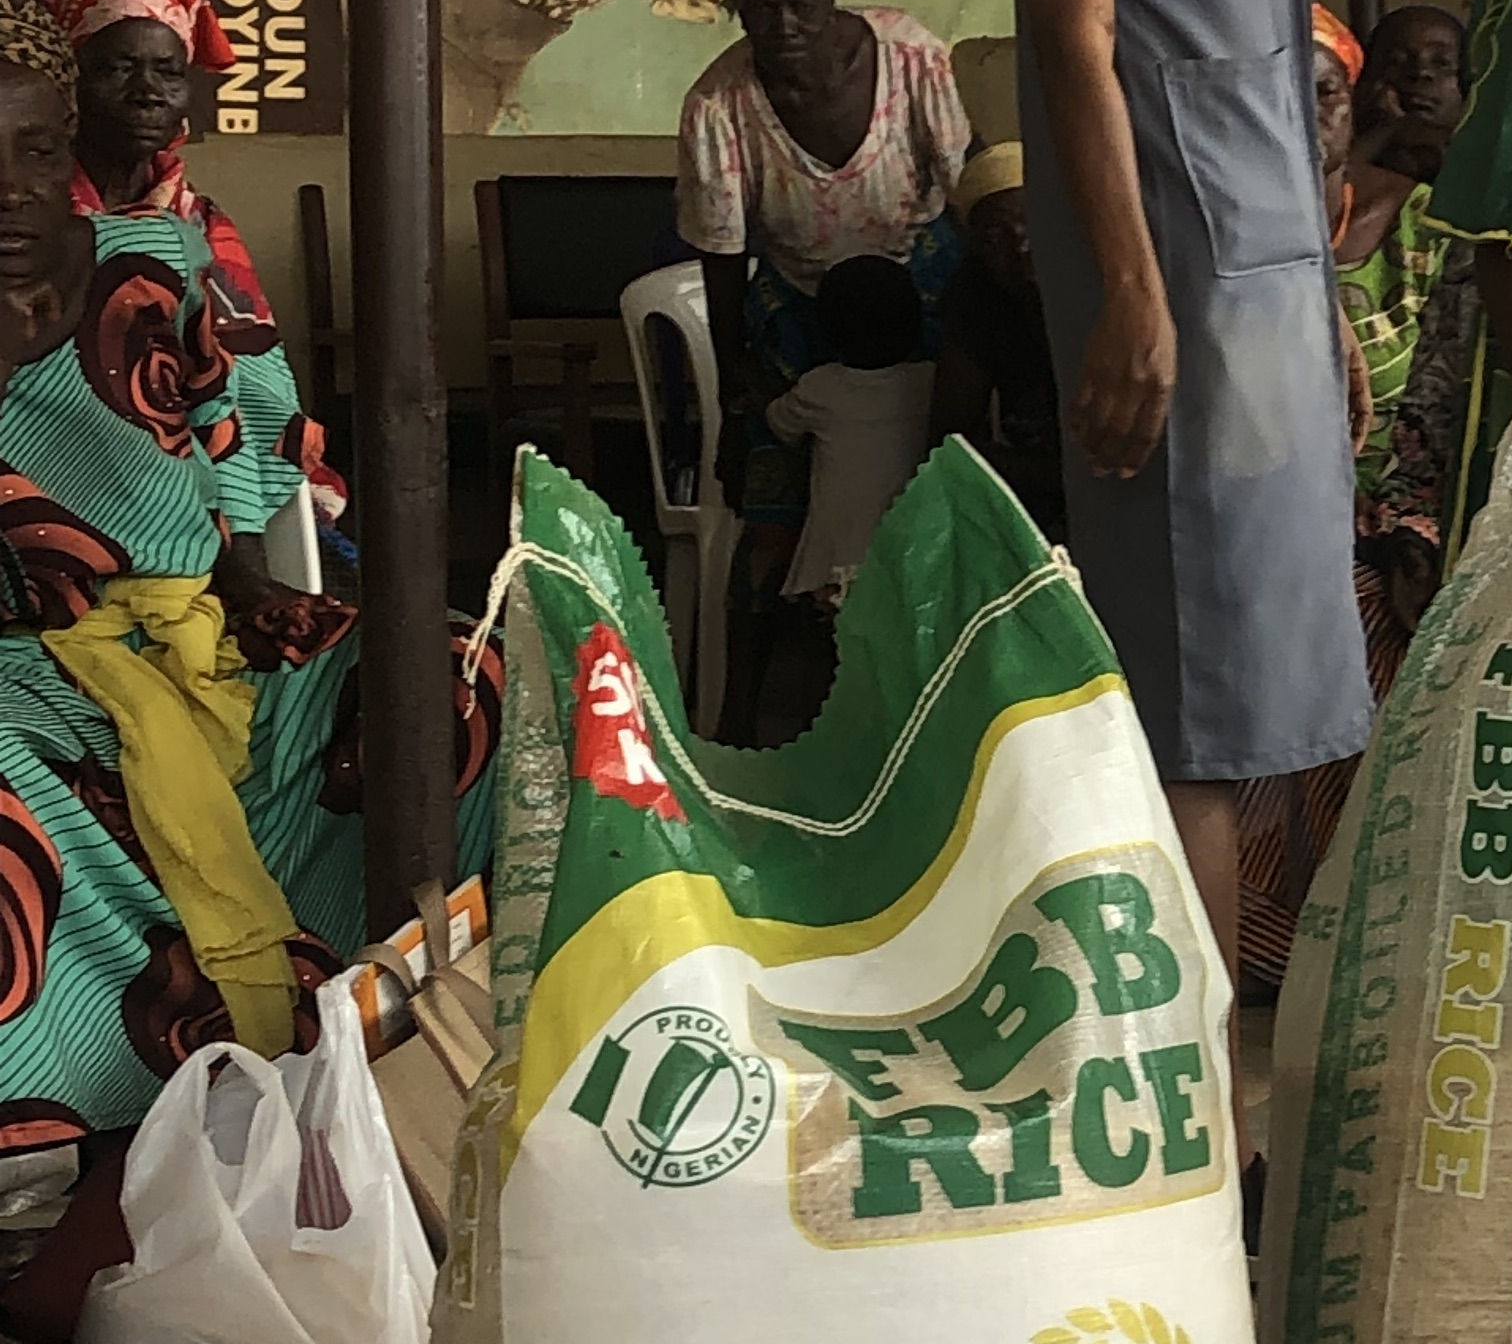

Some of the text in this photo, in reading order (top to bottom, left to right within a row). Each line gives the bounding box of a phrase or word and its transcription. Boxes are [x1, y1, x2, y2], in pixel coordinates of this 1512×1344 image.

[588, 651, 645, 732] 5
[618, 728, 667, 784] K
[778, 870, 1182, 1104] FBB
[1328, 792, 1414, 1223] PARBOILED
[1418, 915, 1511, 1199] RICE
[848, 1040, 1214, 1219] RICE
